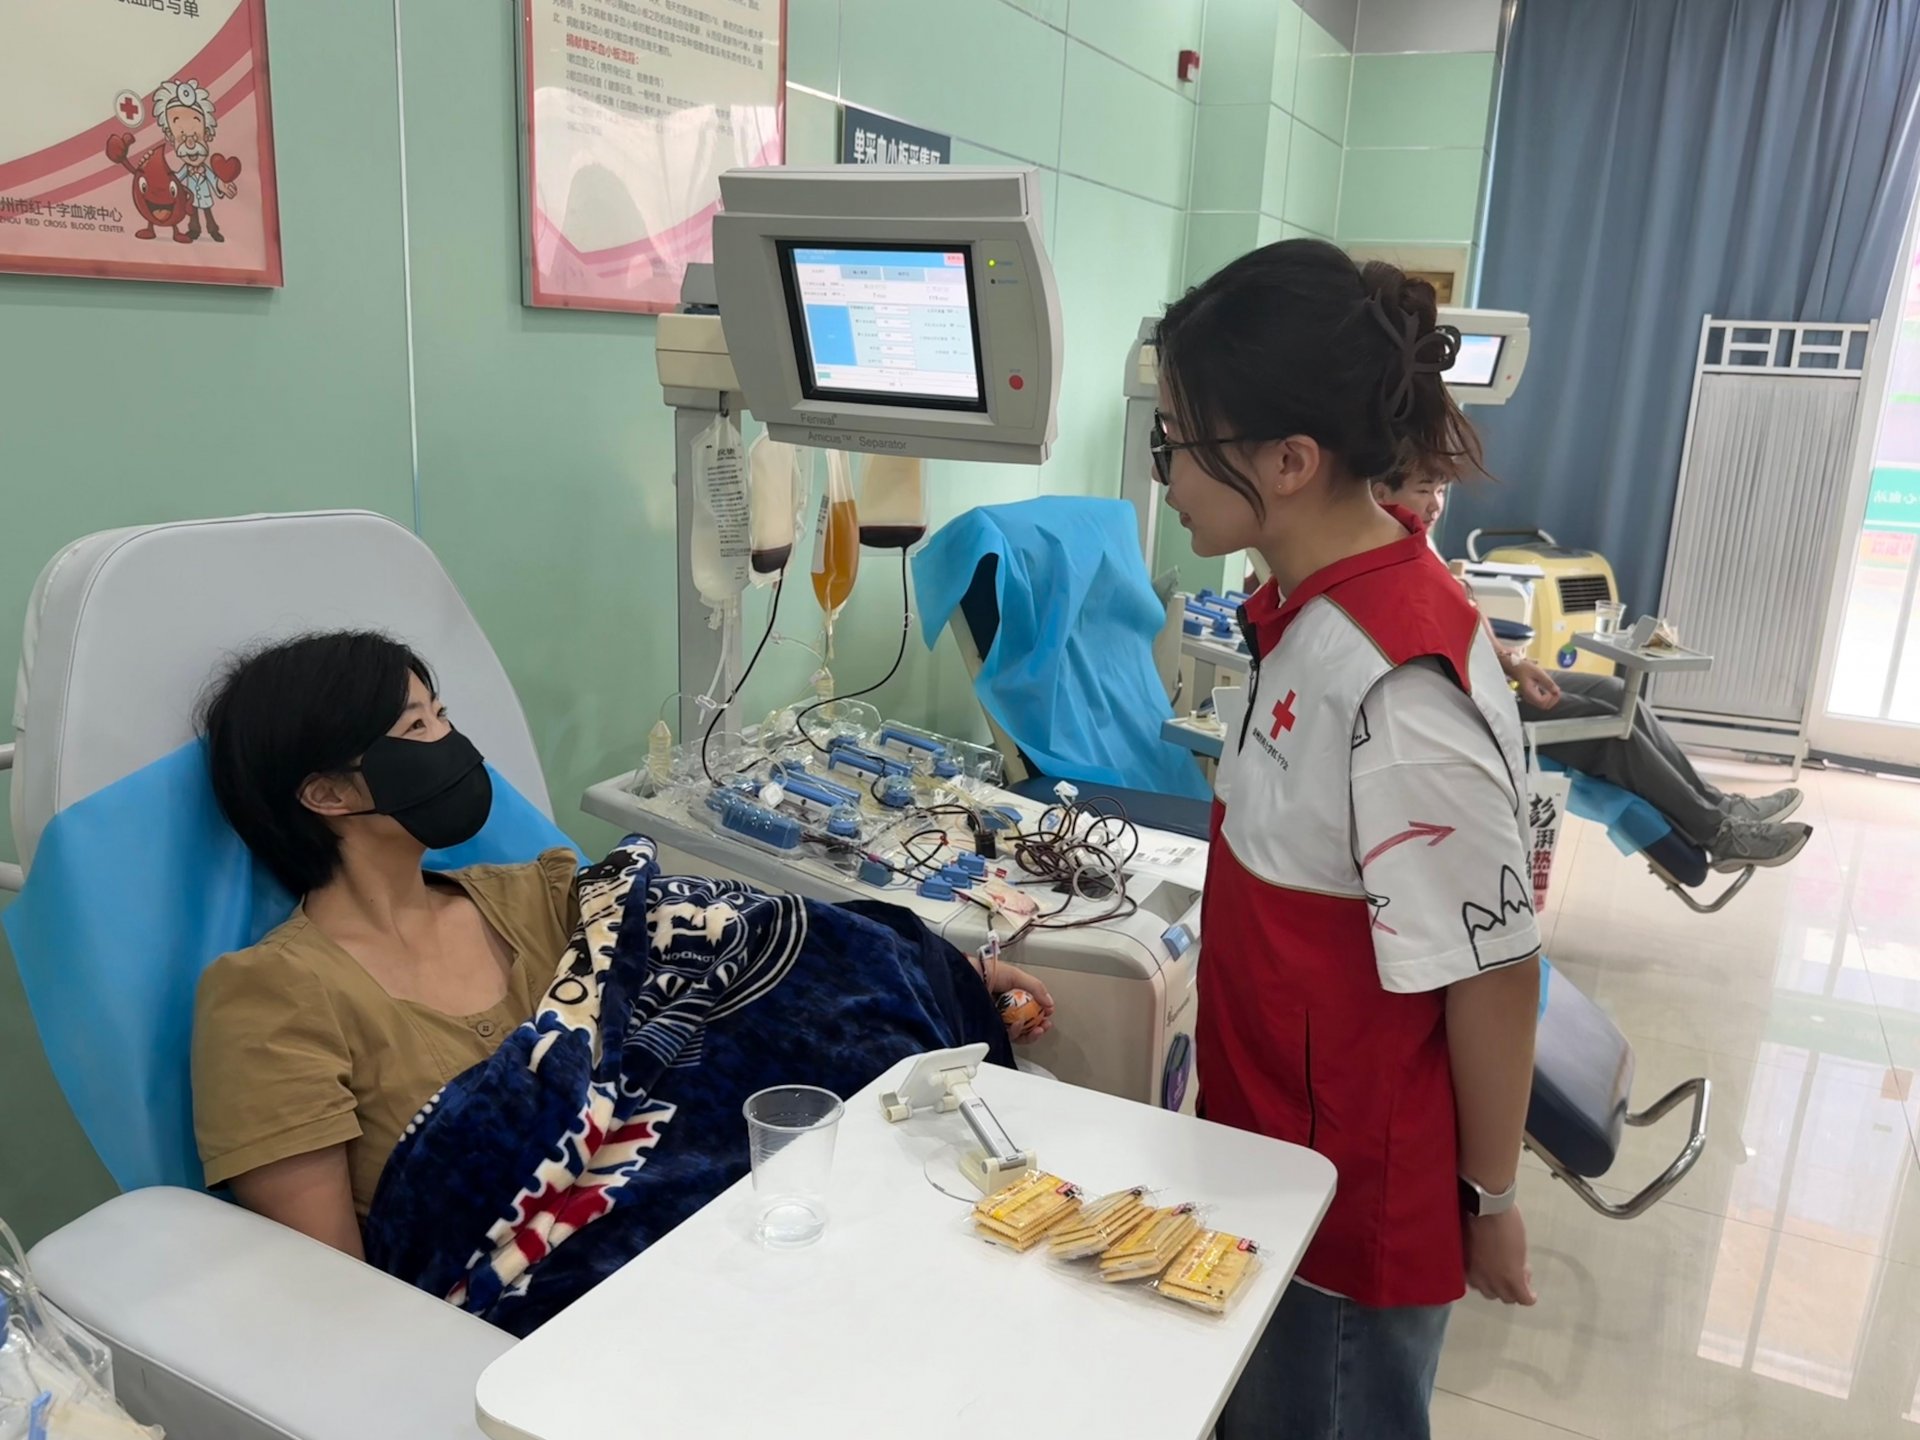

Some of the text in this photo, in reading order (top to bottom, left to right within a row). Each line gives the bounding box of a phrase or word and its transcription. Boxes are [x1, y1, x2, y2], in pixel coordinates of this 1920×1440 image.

[25, 218, 40, 226] RED
[43, 220, 67, 229] CROSS
[71, 222, 95, 231] BLOOD
[98, 224, 125, 233] CENTER
[858, 436, 907, 449] Separator
[662, 951, 716, 962] LONDON
